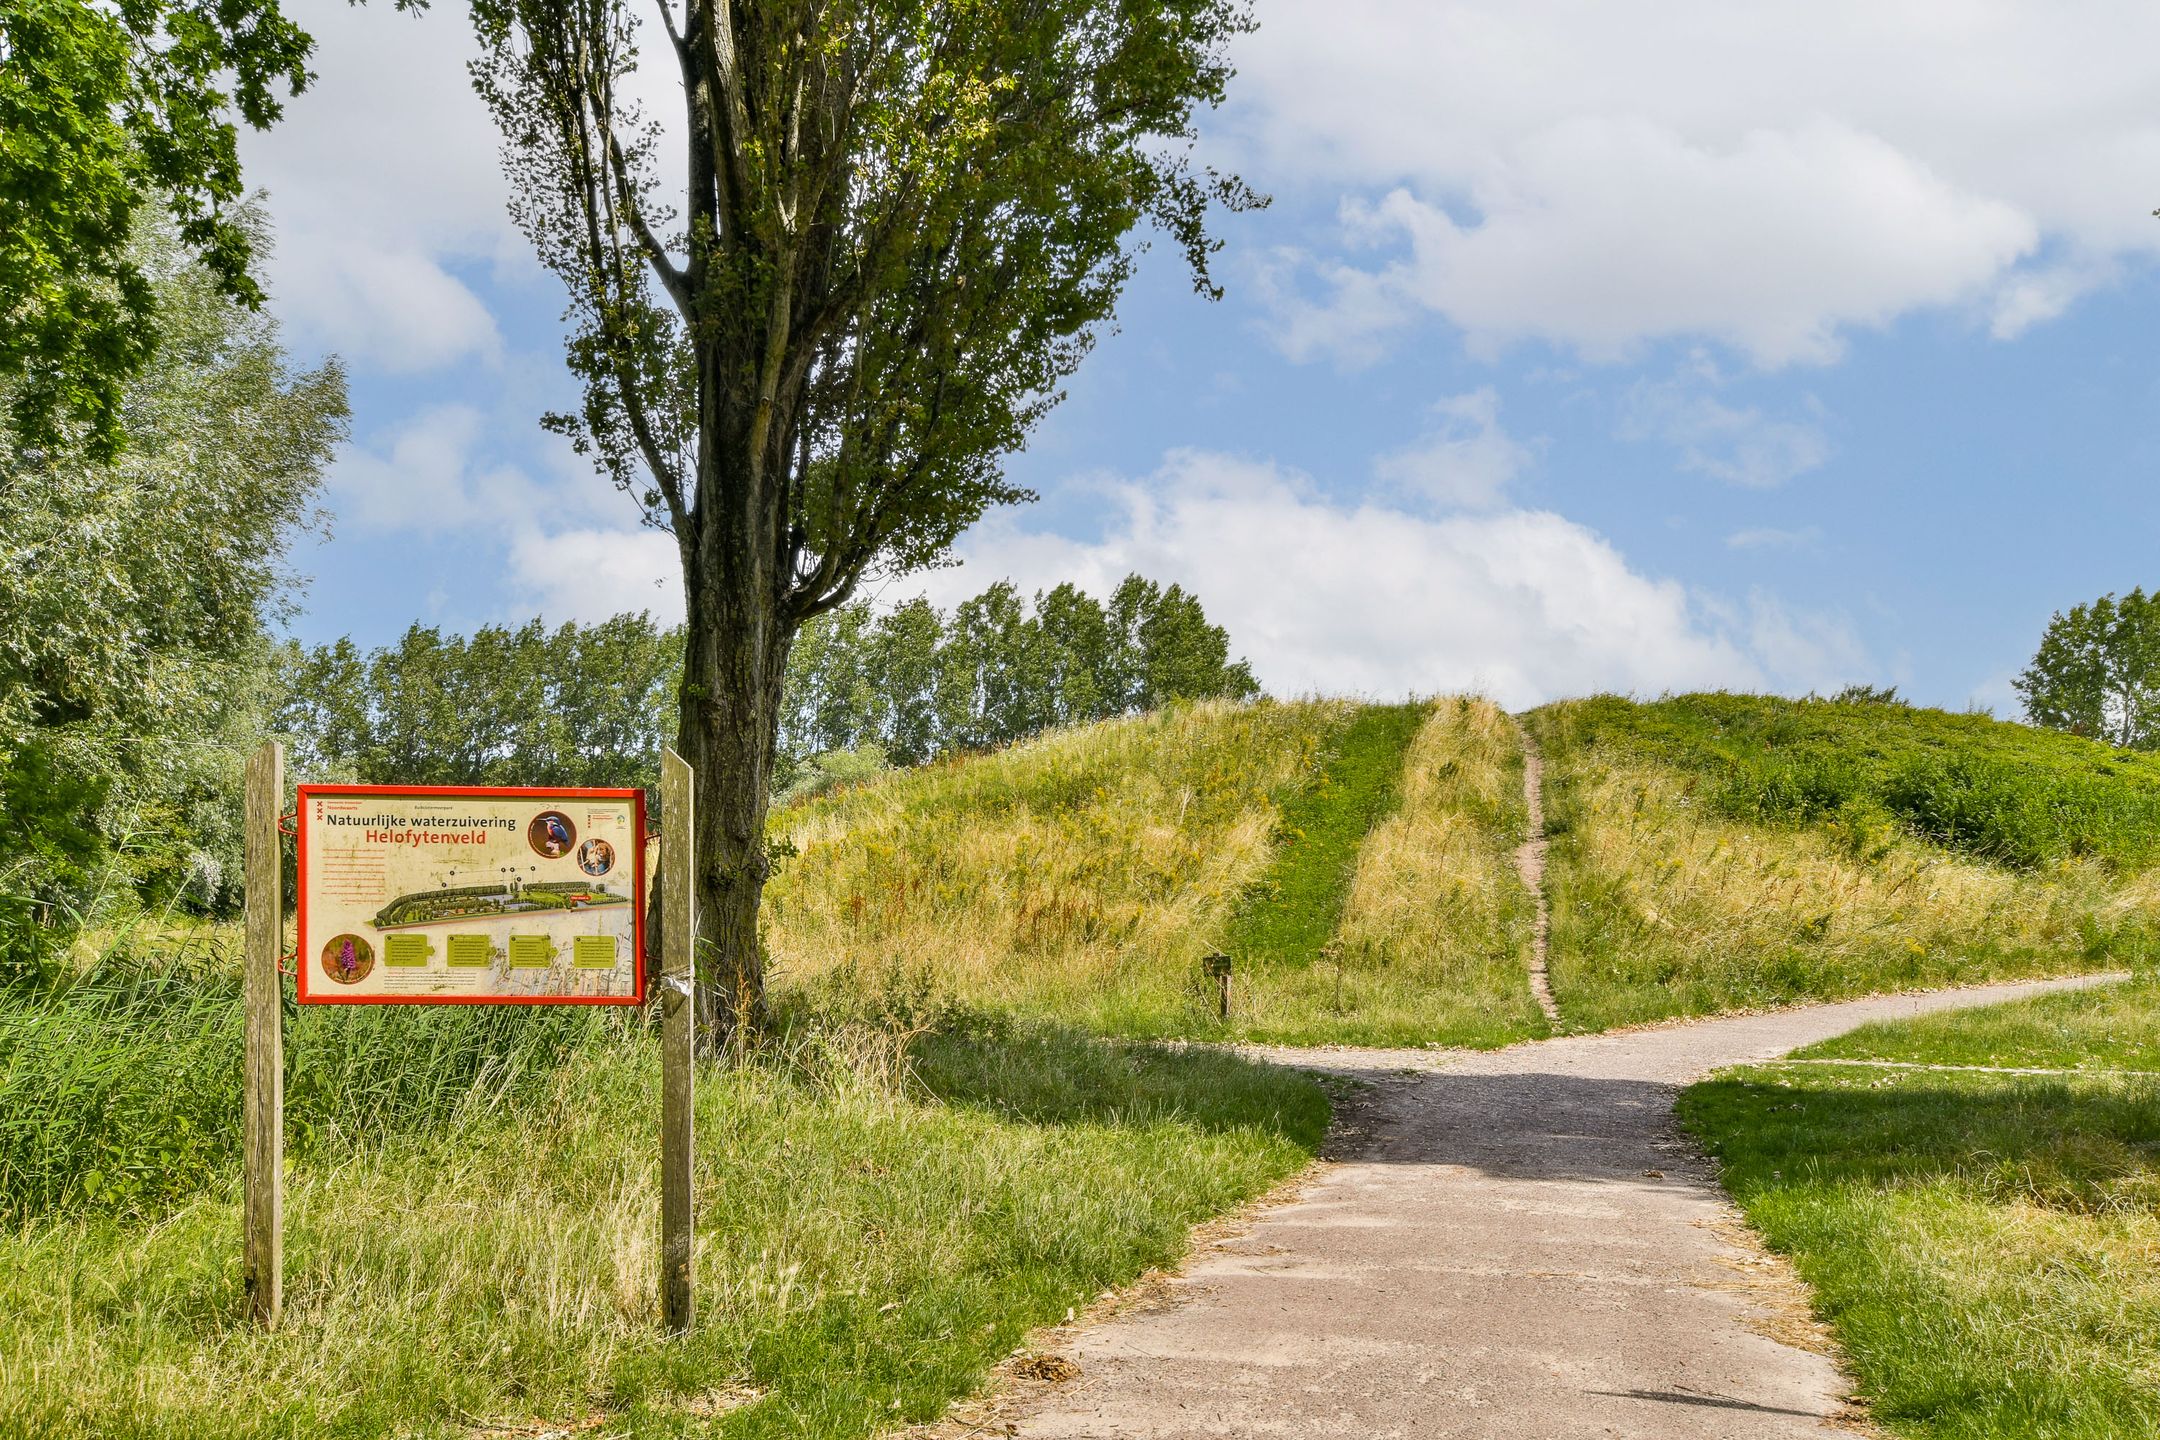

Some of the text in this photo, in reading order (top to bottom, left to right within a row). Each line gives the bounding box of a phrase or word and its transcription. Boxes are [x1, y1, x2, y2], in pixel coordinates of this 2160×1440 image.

[327, 814, 516, 831] Natuurlijke waterzuivering
[366, 829, 486, 847] Helofytenveld
